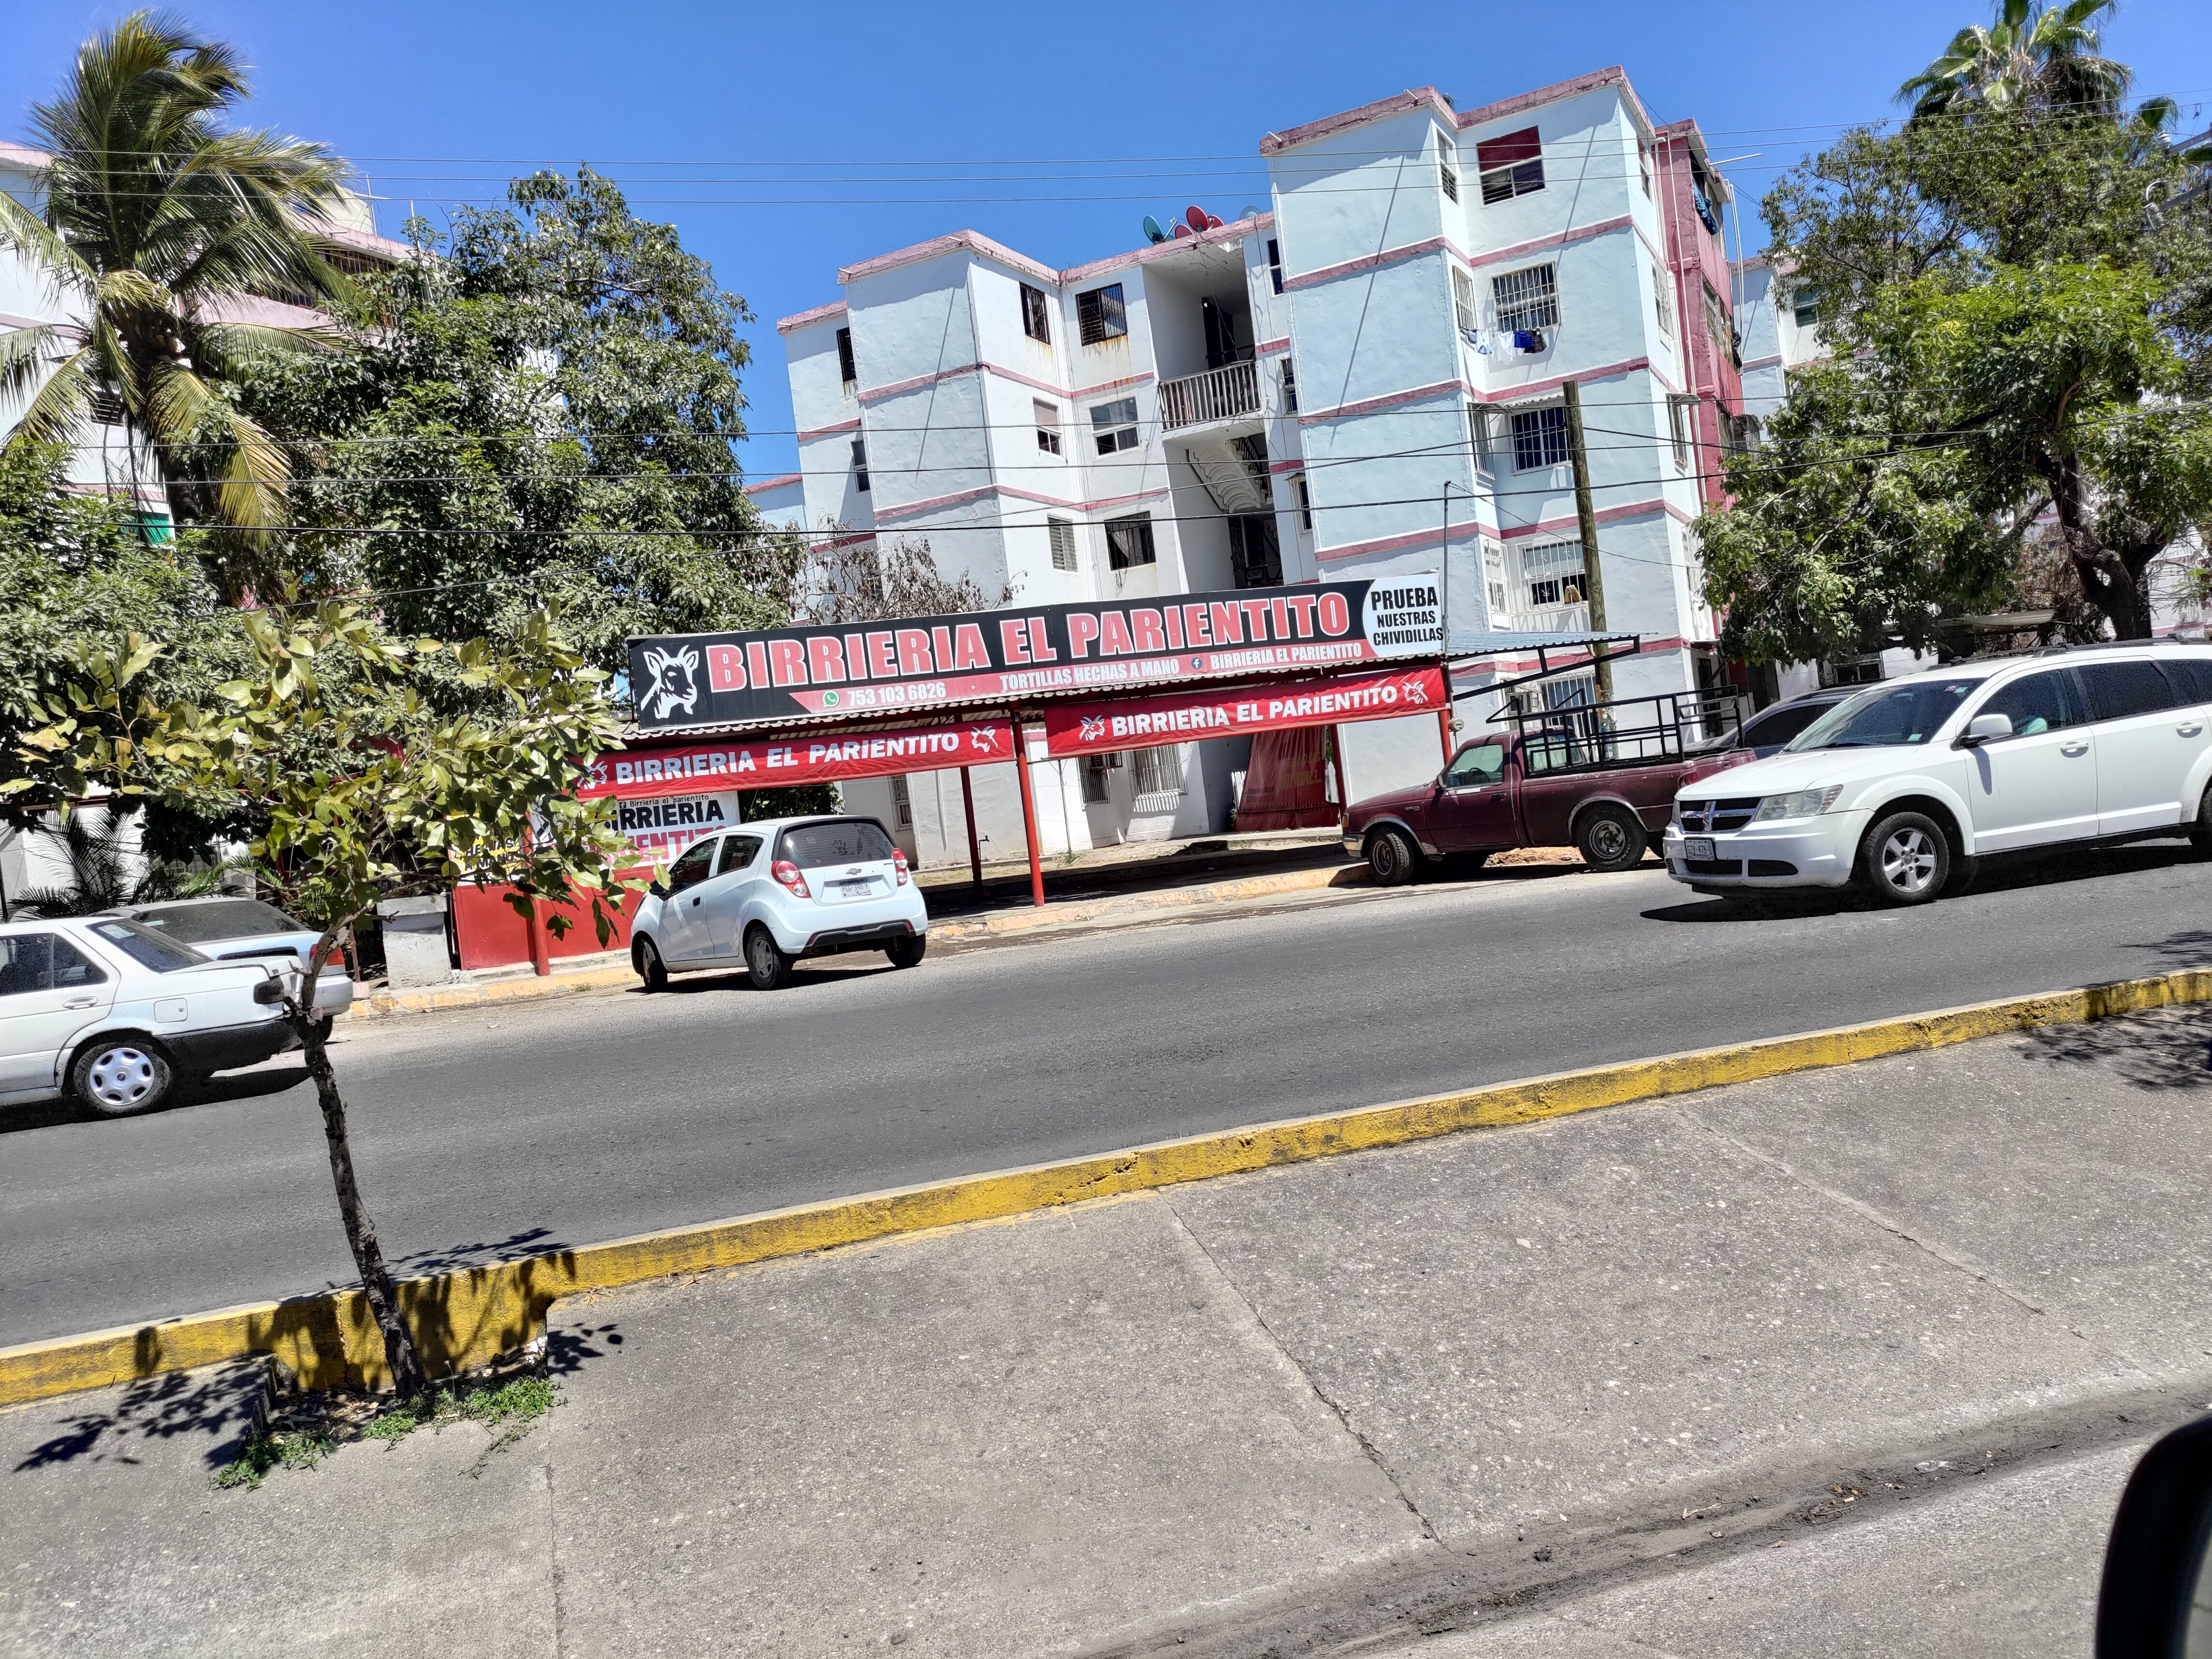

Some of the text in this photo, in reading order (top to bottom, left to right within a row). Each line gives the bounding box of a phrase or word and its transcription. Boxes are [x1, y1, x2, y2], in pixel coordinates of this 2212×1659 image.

[1371, 587, 1438, 611] PRUEBA
[1377, 611, 1436, 628] NUESTRAS
[706, 592, 1350, 693] BIRRIERIA EL PARIENTITO
[1373, 627, 1443, 646] CHIVIDILLAS
[1210, 649, 1275, 670] BIRRIERIA
[1276, 647, 1290, 663] EL
[1291, 642, 1362, 661] PARIENTITO
[1000, 658, 1179, 691] TORTILLAS HECHAS A MANO
[847, 682, 946, 706] 753 103 6826
[1112, 685, 1397, 737] BIRRIERIA EL PARIENTITO
[615, 732, 959, 785] BIRRIERIA EL PARIENTITO
[595, 800, 725, 831] IRRIERIA
